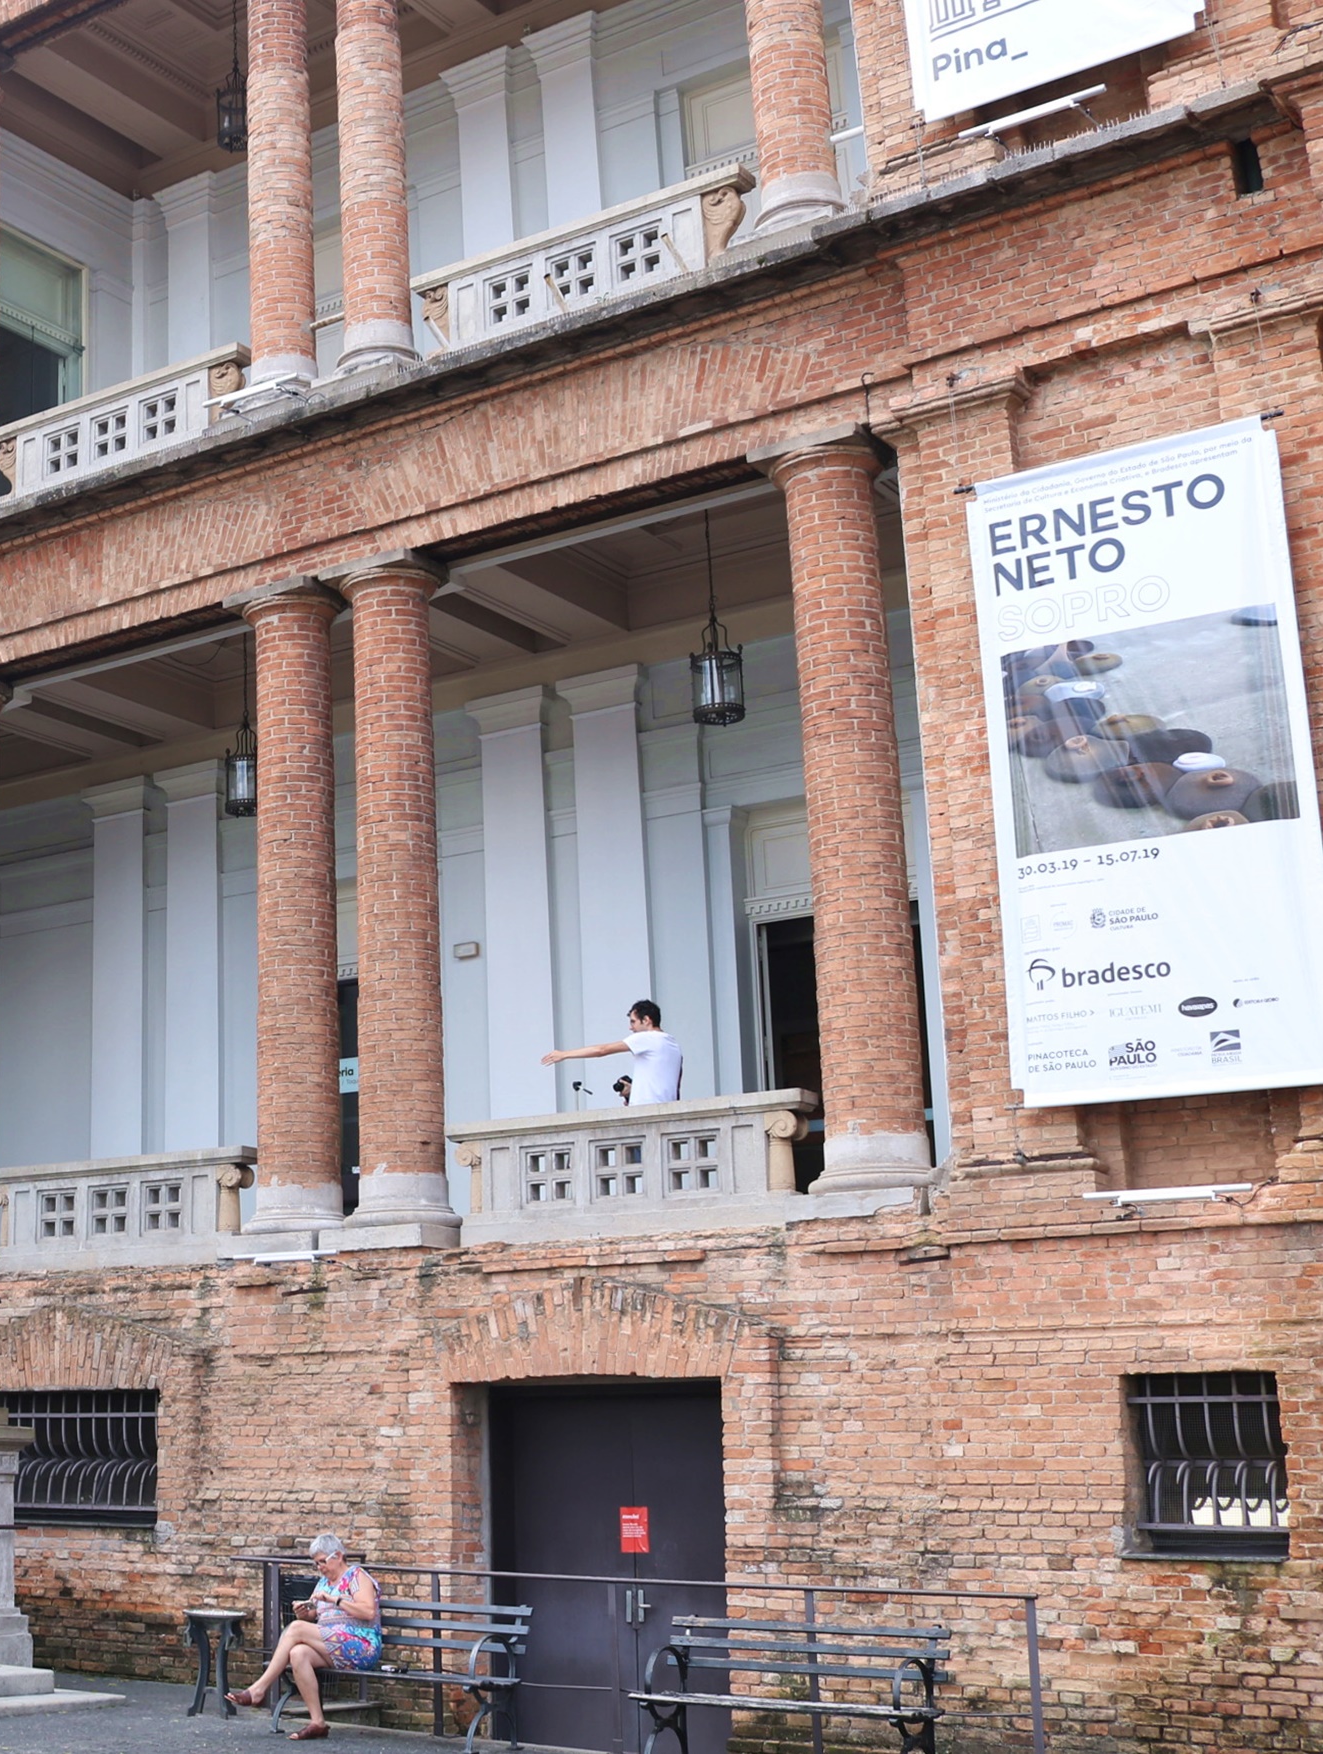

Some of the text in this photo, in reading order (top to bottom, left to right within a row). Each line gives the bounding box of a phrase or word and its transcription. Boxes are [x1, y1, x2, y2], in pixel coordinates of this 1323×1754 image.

[983, 436, 1252, 505] Ministério da Cidadania, Governo do Estado de São Paulo, por meio da
[984, 501, 1021, 513] Secretaria
[1034, 491, 1062, 502] Cultura
[1070, 480, 1108, 493] Economia
[1109, 472, 1144, 485] Criativa,
[1151, 462, 1188, 475] Bradesco
[1189, 449, 1238, 466] apresentam
[988, 473, 1225, 557] ERNESTO
[993, 537, 1126, 597] NETO
[997, 574, 1171, 642] SOPRO
[1017, 858, 1078, 880] 30.03.19
[1097, 847, 1160, 866] 15.07.19
[1108, 906, 1146, 917] CIDADE DE
[1109, 912, 1159, 926] SÃO PAULO
[1061, 961, 1171, 988] bradesco
[1026, 1010, 1087, 1023] MATTOS FILHO
[1109, 1003, 1162, 1018] IGUATEMI
[1125, 1038, 1156, 1053] SÃO
[1028, 1048, 1089, 1061] PINACOTECA
[1109, 1052, 1157, 1067] PAULO
[1211, 1055, 1243, 1064] BRASIL
[1028, 1059, 1096, 1073] DE SÃO PAULO
